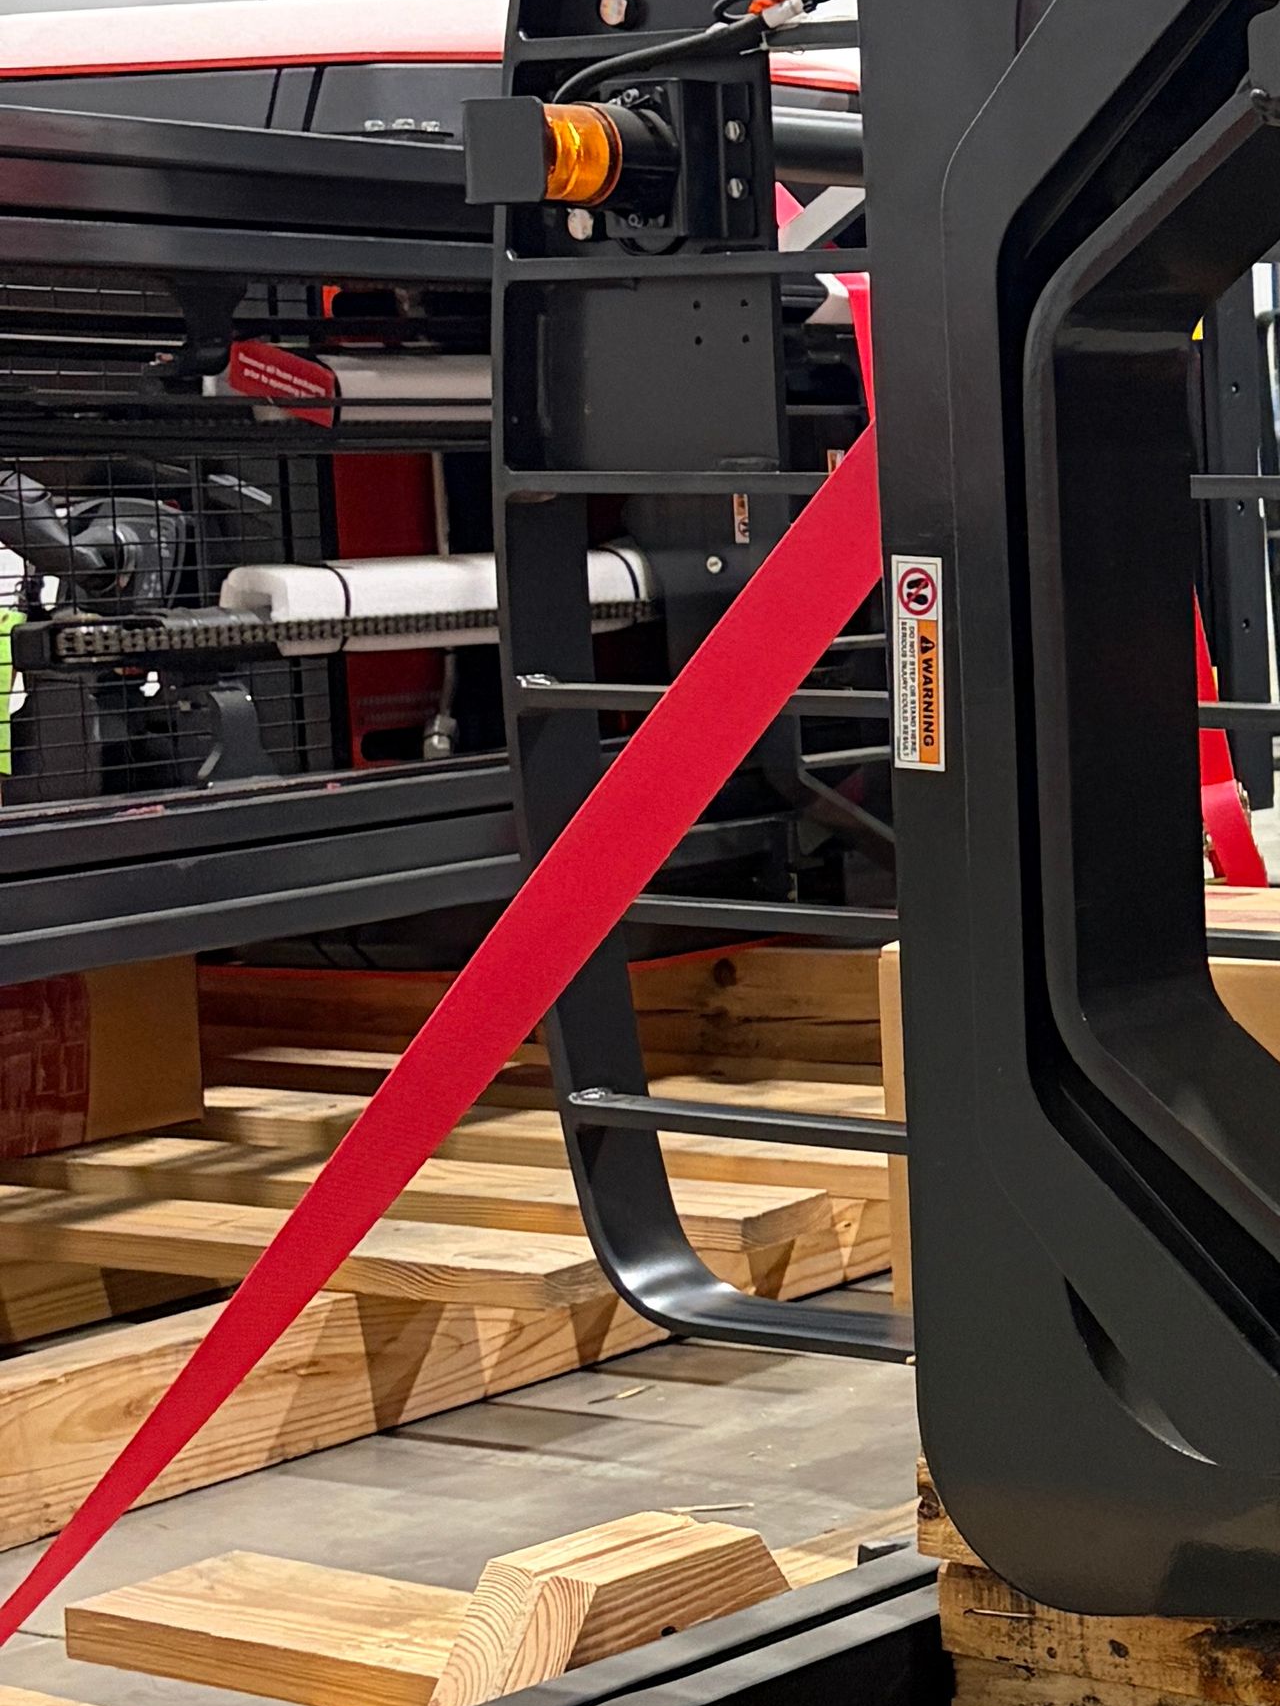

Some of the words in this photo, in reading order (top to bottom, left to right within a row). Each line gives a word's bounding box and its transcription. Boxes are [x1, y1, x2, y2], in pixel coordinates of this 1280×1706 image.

[909, 626, 915, 639] DO
[910, 684, 916, 697] OR
[922, 657, 935, 747] WARNING
